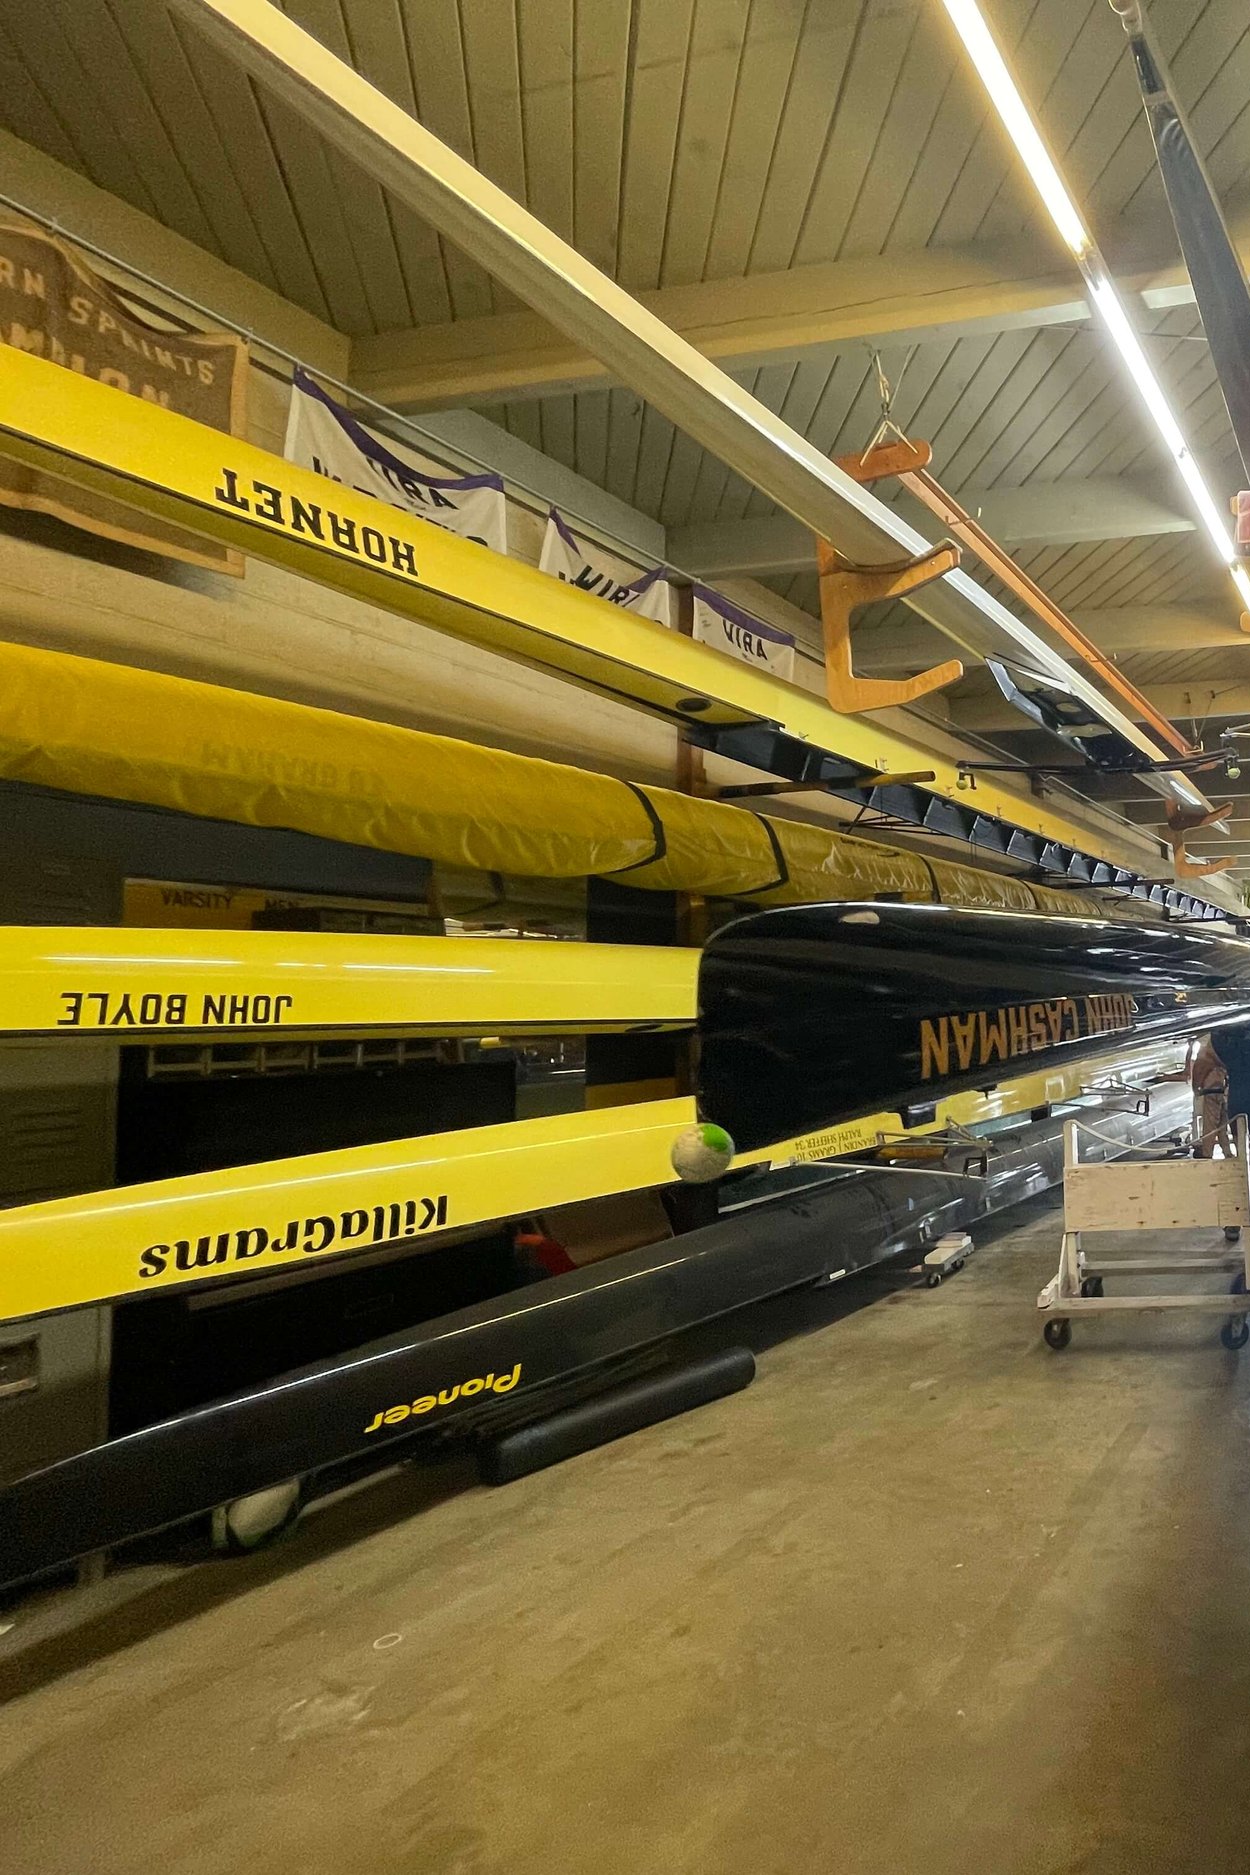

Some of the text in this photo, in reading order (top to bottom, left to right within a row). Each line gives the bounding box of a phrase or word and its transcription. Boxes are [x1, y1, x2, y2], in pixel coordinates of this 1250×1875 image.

[214, 467, 419, 577] HORNET
[161, 889, 232, 910] VARSITY
[57, 992, 293, 1025] JOHN BOYLE
[920, 992, 1138, 1080] JOHN CASHMAN
[139, 1195, 449, 1279] KillaGrams
[363, 1363, 522, 1433] Pioneer
